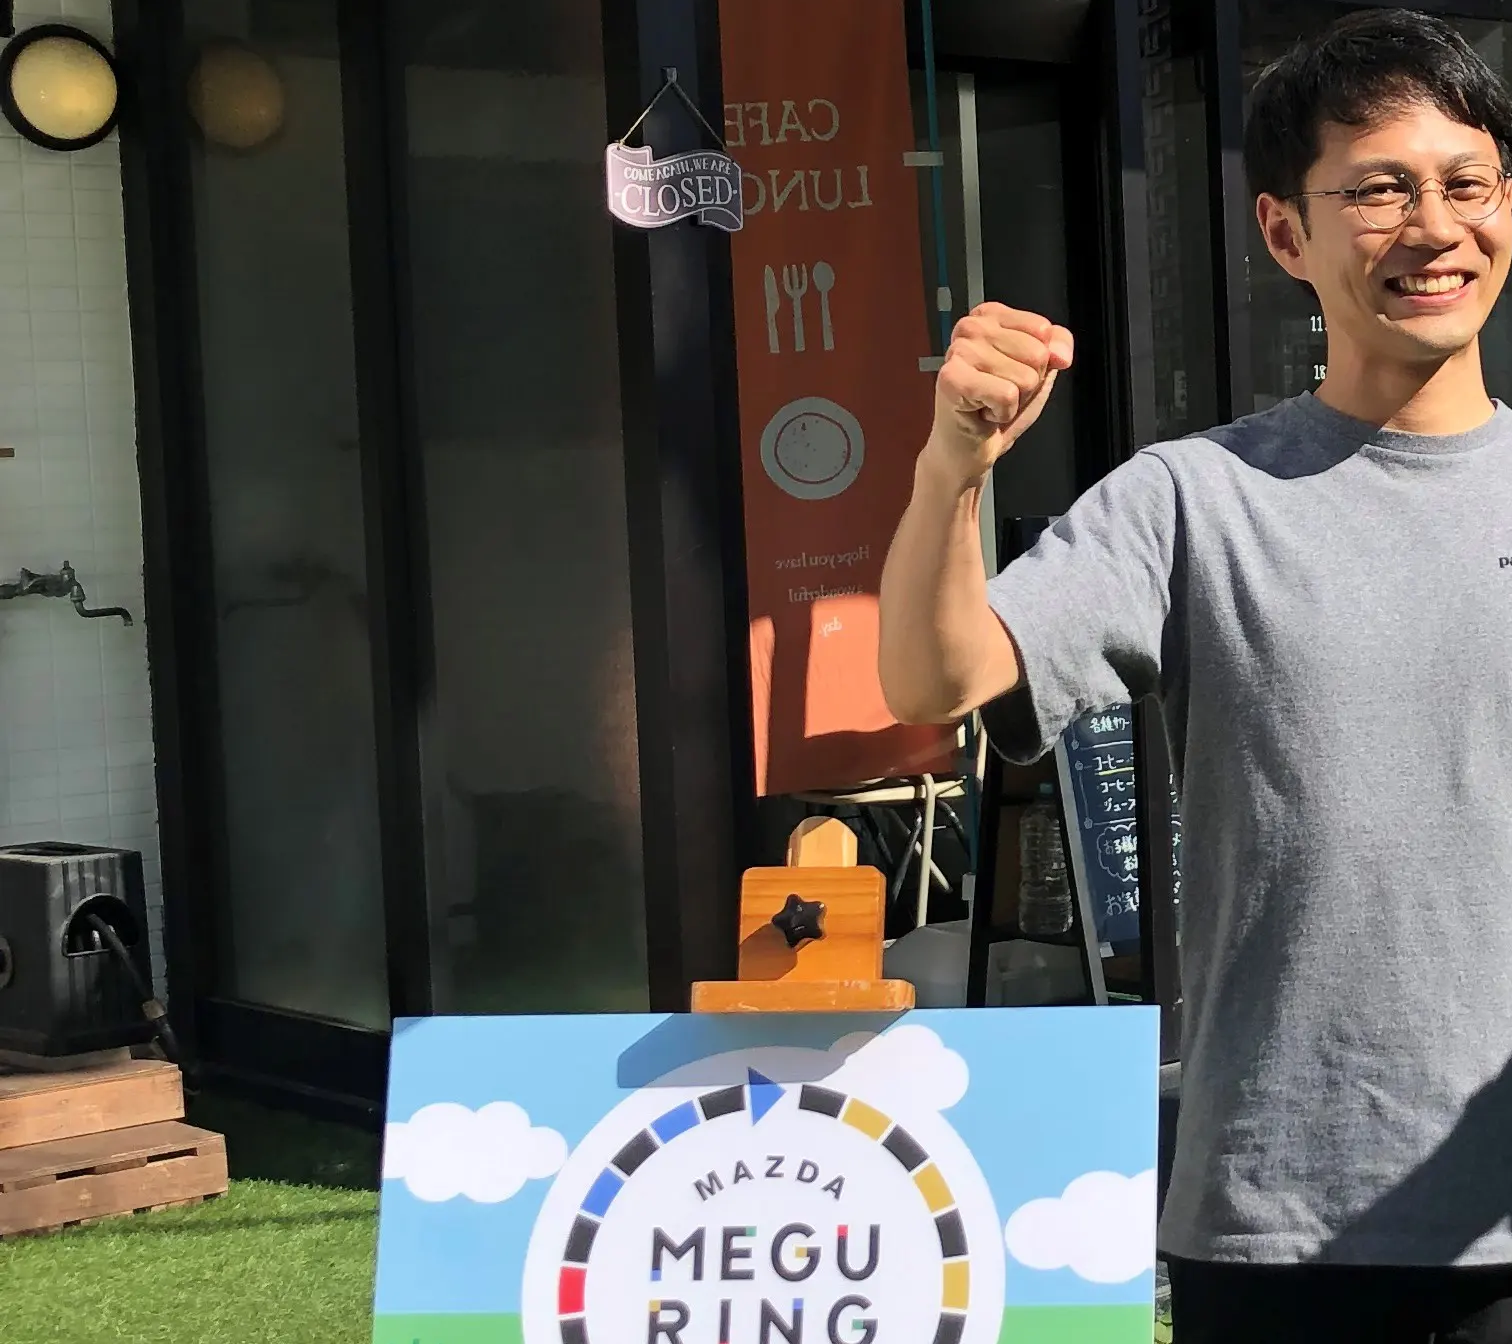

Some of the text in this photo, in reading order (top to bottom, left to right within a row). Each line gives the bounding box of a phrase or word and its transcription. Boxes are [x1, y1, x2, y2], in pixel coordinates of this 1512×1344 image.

[623, 166, 655, 182] COME
[693, 157, 710, 171] WE
[710, 158, 731, 175] ARE
[621, 176, 733, 216] CLOSED
[694, 1155, 846, 1201] MAZDA
[651, 1222, 881, 1282] MEGU
